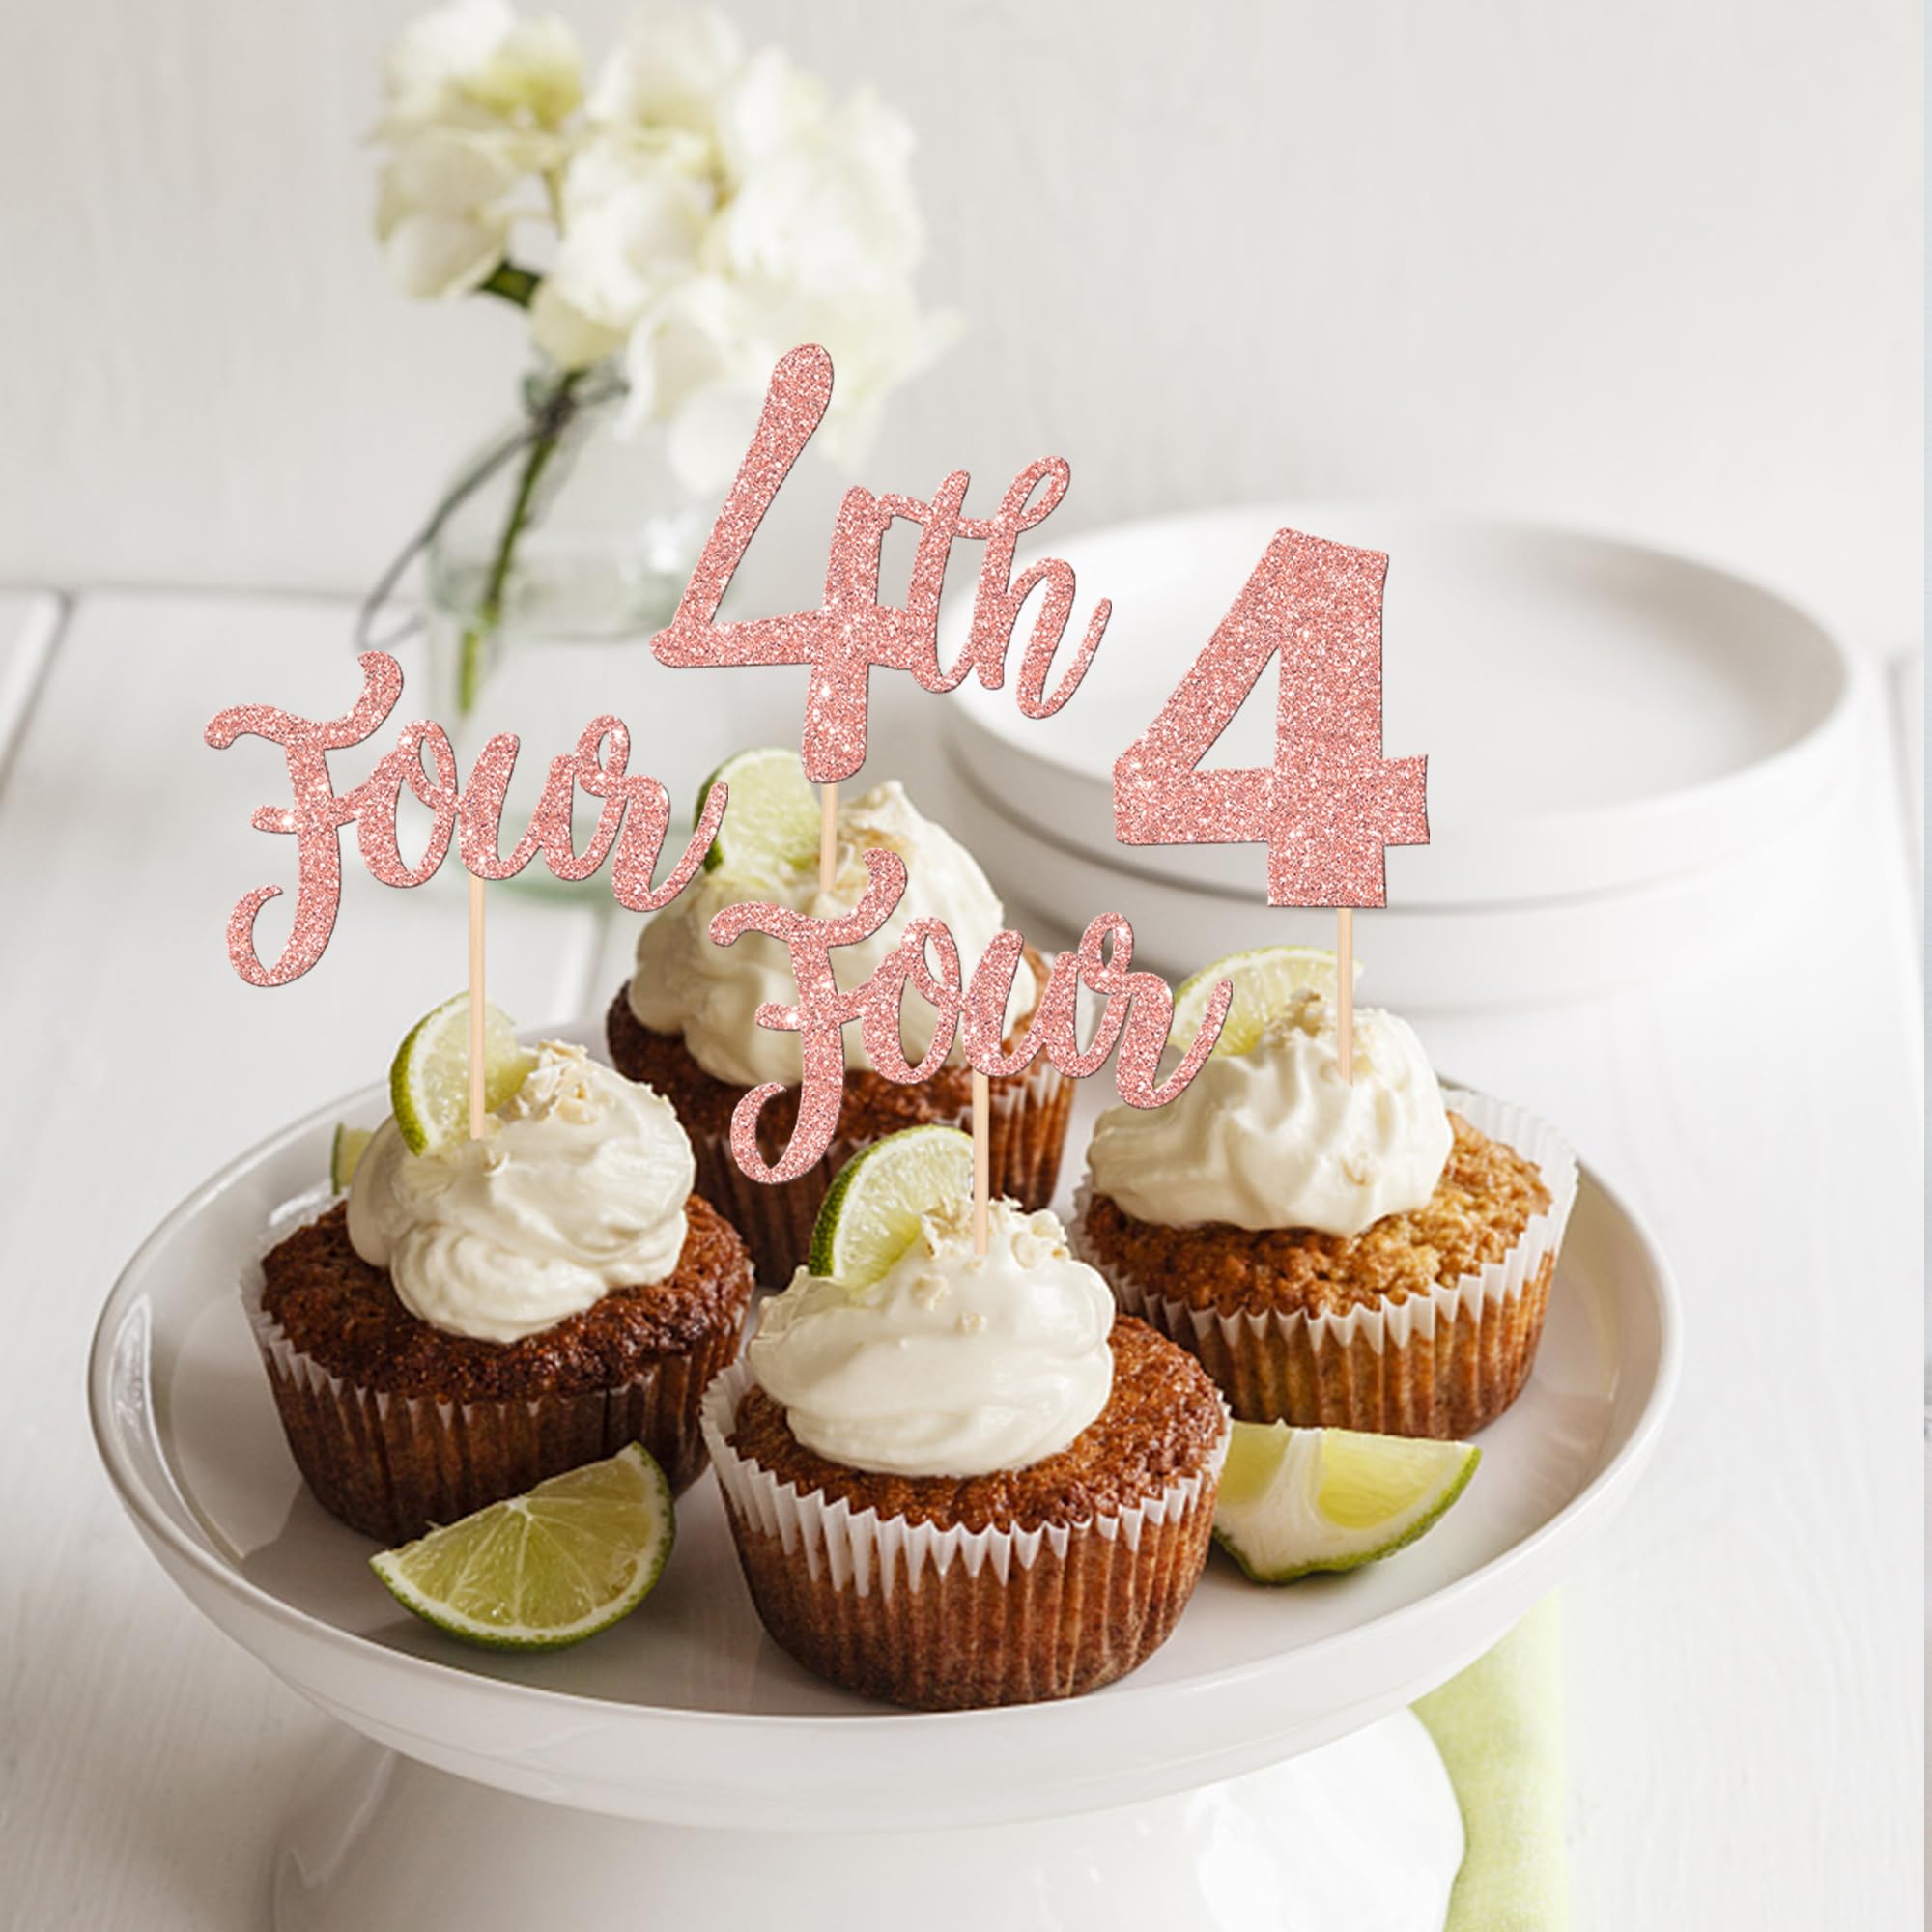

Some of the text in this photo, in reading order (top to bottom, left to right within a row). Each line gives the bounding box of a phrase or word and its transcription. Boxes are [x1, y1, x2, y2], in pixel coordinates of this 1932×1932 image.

[649, 343, 1112, 783] 4th
[1113, 528, 1430, 908] 4
[205, 651, 728, 987] Four
[709, 848, 1233, 1186] Four
